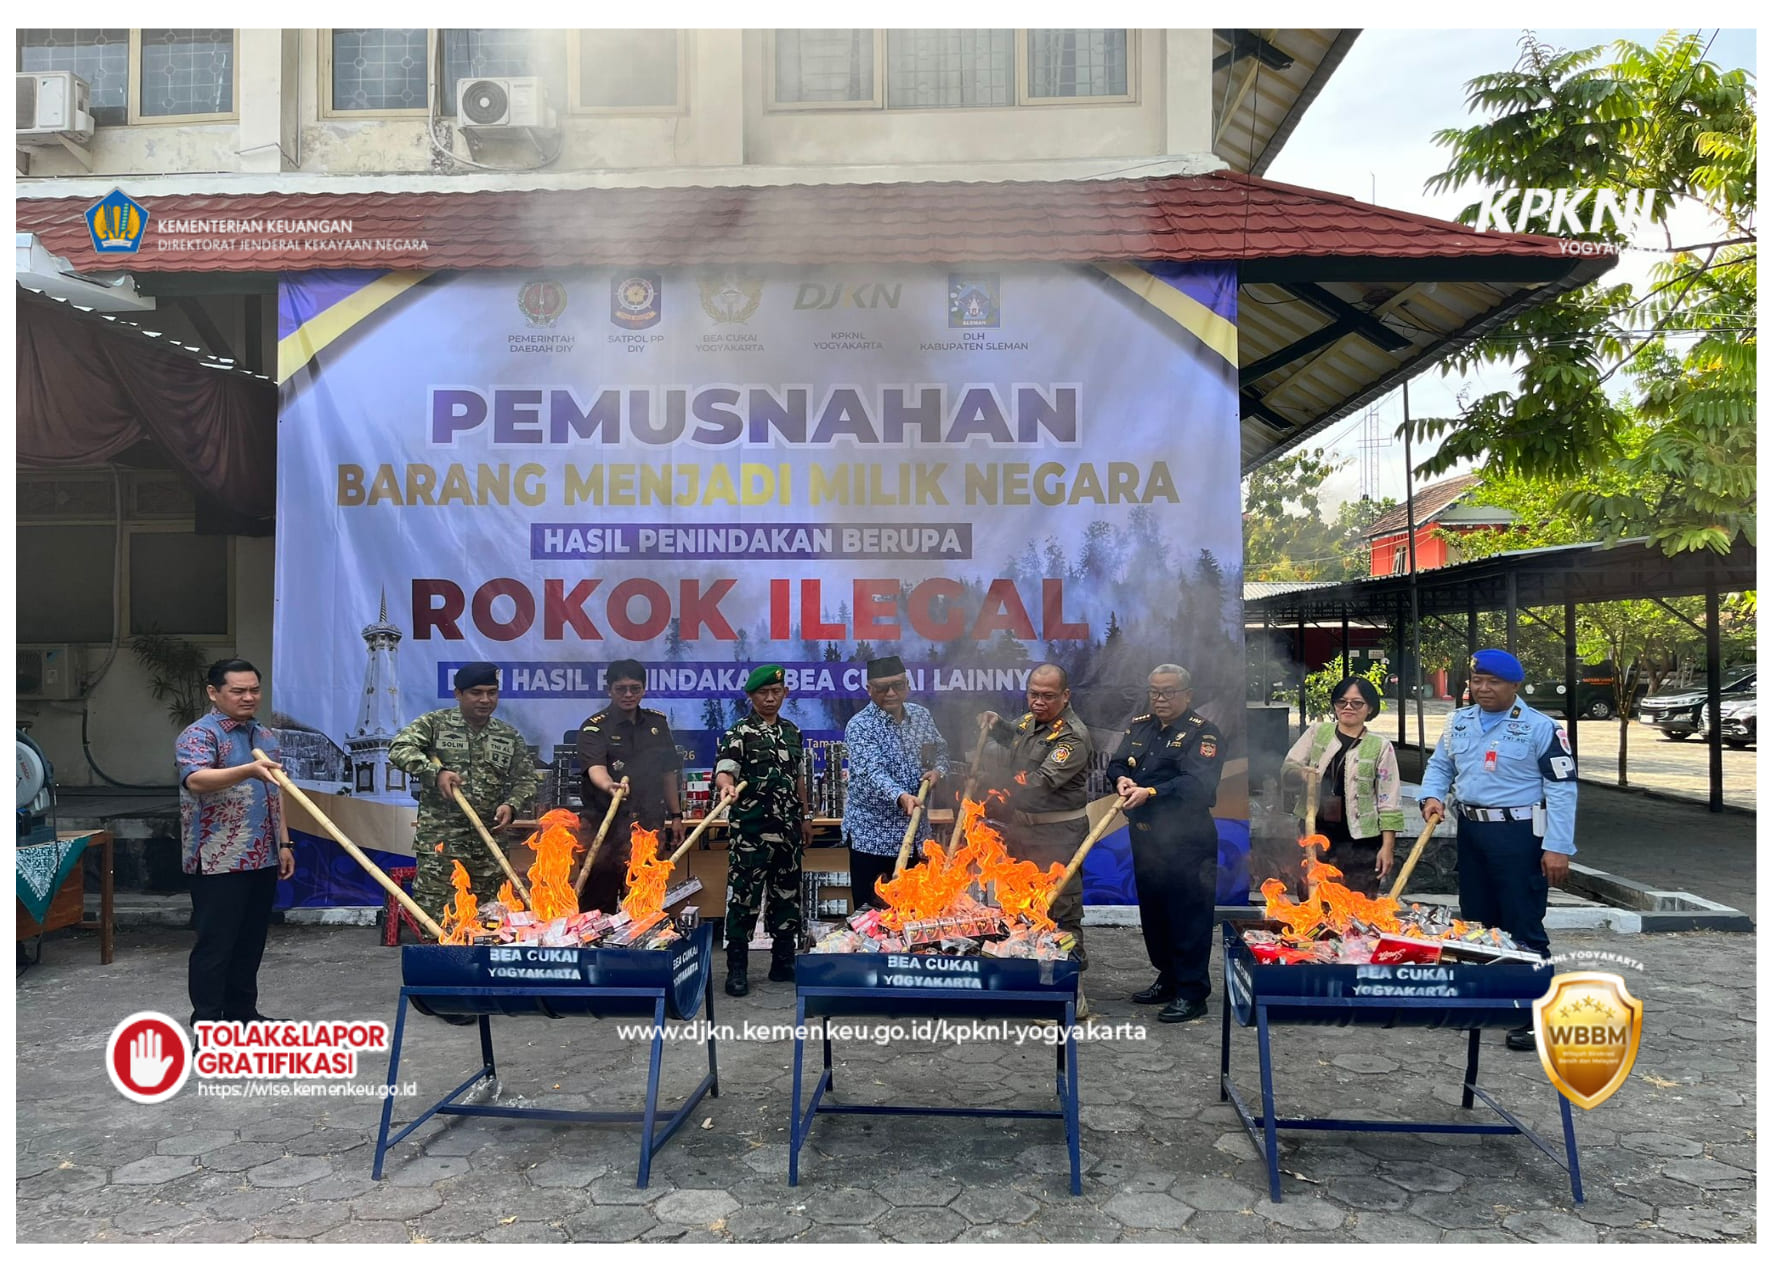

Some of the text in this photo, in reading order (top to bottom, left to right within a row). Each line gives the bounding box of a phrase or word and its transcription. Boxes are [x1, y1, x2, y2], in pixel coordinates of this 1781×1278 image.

[793, 283, 904, 310] DJKN
[507, 335, 576, 344] PEMERINTAH
[607, 335, 665, 344] SATPOL PP
[702, 334, 759, 343] BEA CUKAI
[830, 332, 867, 340] KPKNL
[962, 332, 985, 341] DLH
[509, 344, 574, 353] DAERAH DIY
[627, 344, 645, 353] DIY
[695, 343, 766, 353] YOGYAKARTA
[813, 341, 884, 350] YOGYAKARTA
[919, 342, 1029, 351] KABUPATEN SLEMAN
[430, 386, 1079, 446] PEMUSNAHAN
[337, 460, 1181, 508] BARANG MENJADI MILIK NEGARA
[543, 528, 963, 553] HASIL PENINDAKAN BERUPA
[411, 577, 1090, 642] ROKOK ILEGAL
[512, 668, 589, 692] HASIL
[784, 668, 836, 692] BEA
[933, 668, 1032, 692] LAINNY
[441, 741, 464, 749] SOLIN
[1550, 757, 1574, 779] P
[489, 948, 579, 964] BEA CUKAI
[887, 955, 980, 973] BEA CUKAI
[487, 967, 582, 981] YOGYAKARTA
[1396, 967, 1455, 982] CUKAI
[883, 974, 983, 990] YOGYAKARTA
[1352, 985, 1458, 998] YOGYAKARTA
